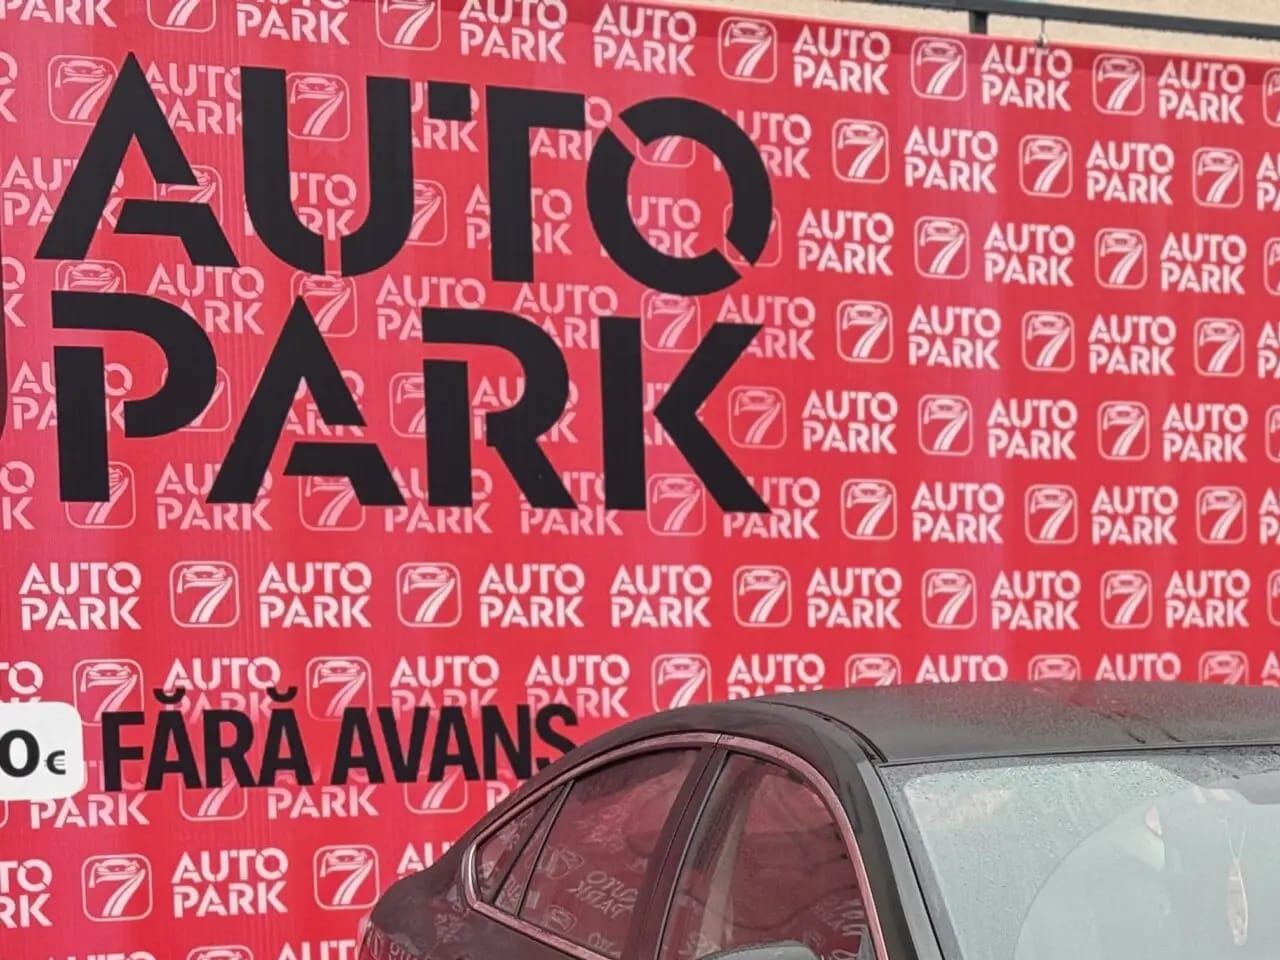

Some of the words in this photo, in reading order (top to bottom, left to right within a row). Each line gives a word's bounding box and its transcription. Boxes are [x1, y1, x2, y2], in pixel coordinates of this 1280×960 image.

[237, 4, 348, 44] PARK
[459, 0, 567, 30] AUTO
[593, 5, 696, 42] AUTO
[461, 23, 564, 63] PARK
[594, 36, 693, 75] PARK
[794, 27, 890, 61] AUTO
[794, 56, 888, 94] PARK
[981, 45, 1071, 78] AUTO
[982, 74, 1070, 110] PARK
[1158, 62, 1244, 93] AUTO
[1159, 89, 1243, 123] PARK
[904, 127, 998, 161] AUTO
[1087, 142, 1174, 173] AUTO
[34, 51, 773, 296] AUTO
[906, 157, 996, 193] PARK
[1088, 171, 1172, 204] PARK
[627, 195, 701, 230] UTO
[798, 209, 893, 243] AUTO
[984, 223, 1074, 255] AUTO
[1161, 233, 1246, 264] AUTO
[800, 240, 892, 275] PARK
[985, 252, 1072, 286] PARK
[148, 265, 264, 298] AUTO
[377, 277, 484, 308] AUTO
[1162, 262, 1244, 293] PARK
[514, 284, 617, 315] AUTO
[909, 306, 1000, 338] AUTO
[1089, 315, 1176, 345] AUTO
[909, 336, 999, 369] PARK
[1090, 344, 1174, 375] PARK
[50, 294, 771, 513] PARK
[803, 391, 897, 421] AUTO
[988, 400, 1077, 429] AUTO
[1163, 404, 1247, 432] AUTO
[804, 421, 896, 453] PARK
[989, 428, 1075, 459] PARK
[1164, 432, 1245, 461] PARK
[912, 483, 1004, 513] AUTO
[1092, 486, 1178, 514] AUTO
[158, 498, 272, 531] PARK
[385, 502, 492, 533] PARK
[521, 507, 622, 536] PARK
[913, 512, 1002, 543] PARK
[1093, 516, 1176, 544] PARK
[19, 562, 141, 595] AUTO
[259, 562, 371, 594] AUTO
[479, 564, 584, 594] AUTO
[611, 565, 711, 595] AUTO
[807, 568, 901, 597] AUTO
[991, 571, 1080, 599] AUTO
[1166, 570, 1250, 598] AUTO
[22, 597, 140, 630] PARK
[260, 596, 370, 627] PARK
[481, 596, 583, 626] PARK
[612, 597, 709, 627] PARK
[808, 598, 900, 627] PARK
[992, 601, 1078, 629] PARK
[1167, 599, 1248, 627] PARK
[164, 657, 280, 690] AUTO
[391, 656, 499, 686] AUTO
[527, 655, 629, 685] AUTO
[727, 654, 825, 684] AUTO
[916, 654, 1008, 683] AUTO
[1095, 653, 1181, 681] AUTO
[101, 686, 315, 792] FĂRĂ
[331, 703, 578, 787] AVANS
[30, 793, 149, 829] PARK
[269, 786, 377, 818] PARK
[173, 848, 288, 883] AUTO
[174, 882, 286, 917] PARK
